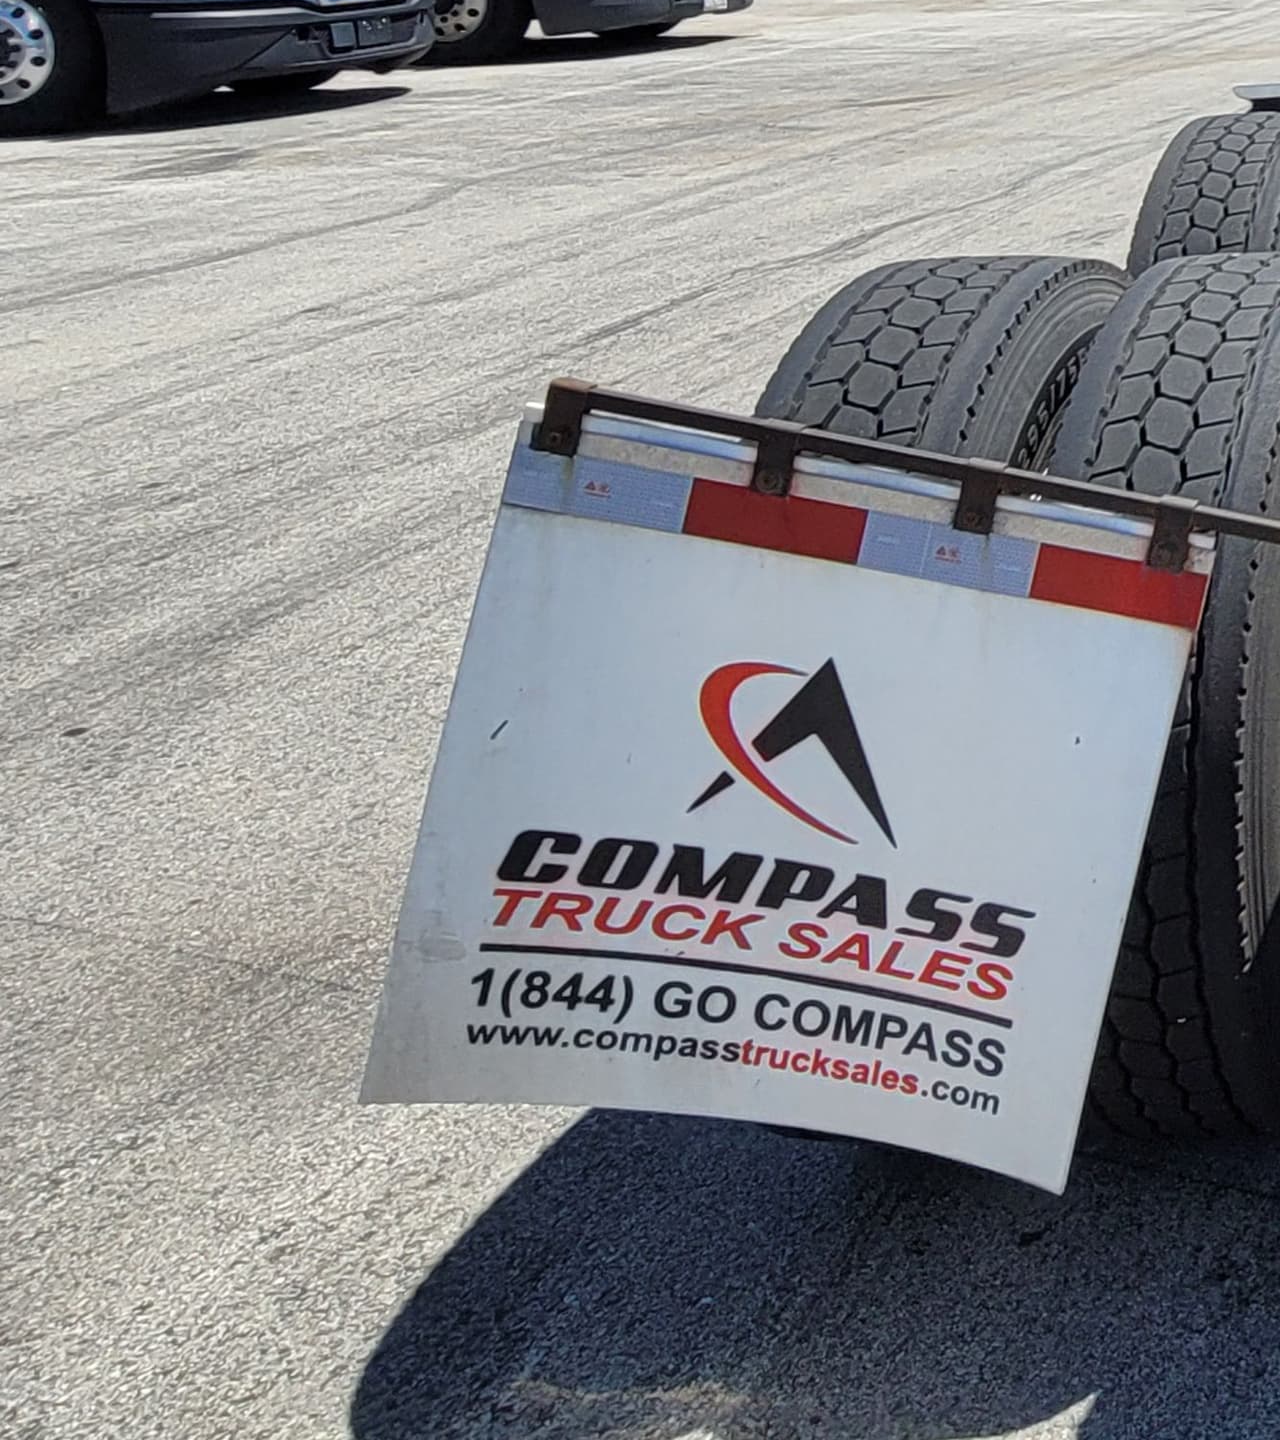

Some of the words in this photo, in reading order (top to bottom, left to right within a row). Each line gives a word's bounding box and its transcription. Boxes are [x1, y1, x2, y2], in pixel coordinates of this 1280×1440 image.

[492, 888, 766, 951] TRUCK
[777, 922, 1014, 1001] SALES
[496, 829, 1037, 958] COMPASS
[466, 1021, 1001, 1116] www.compasstrucksales.com
[469, 968, 634, 1024] 1(844)
[653, 980, 737, 1023] GO
[753, 993, 1007, 1078] COMPASS
